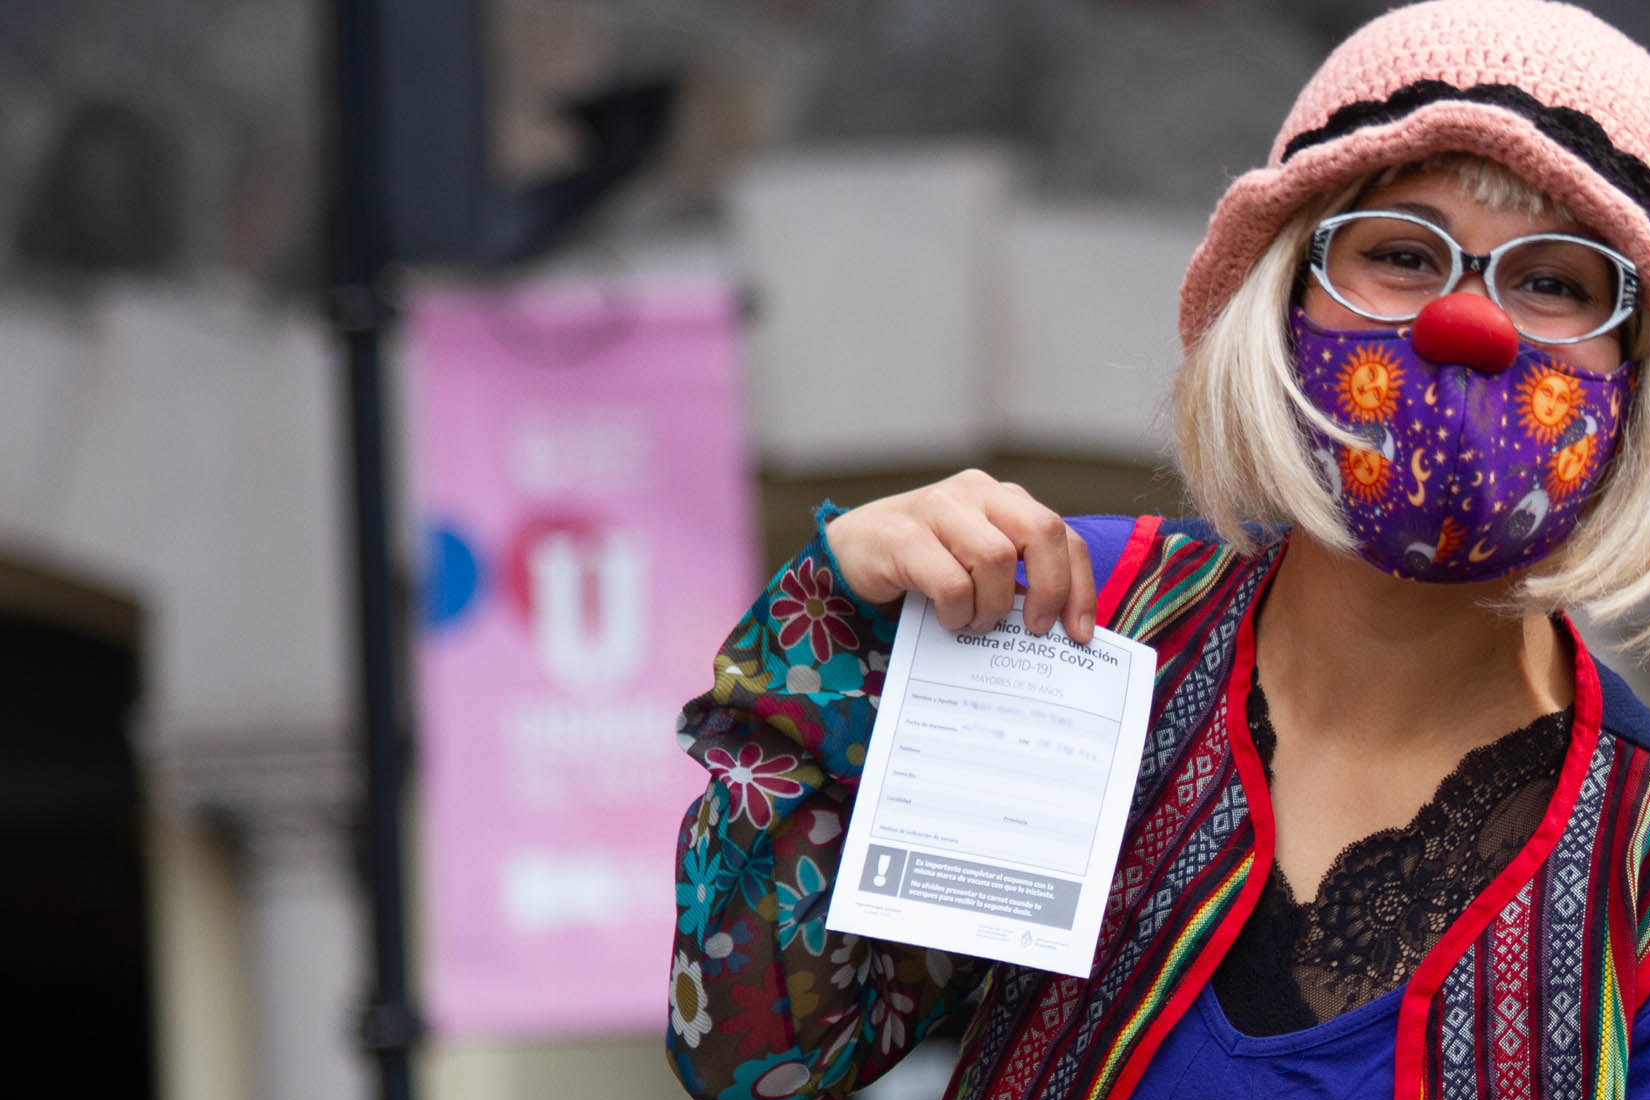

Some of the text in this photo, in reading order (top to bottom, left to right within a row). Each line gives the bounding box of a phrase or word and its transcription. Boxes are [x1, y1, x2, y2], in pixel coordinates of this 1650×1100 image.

[989, 618, 1021, 635] nico
[956, 633, 1095, 672] contra el SARS CoV2
[990, 655, 1053, 679] (COVID-19)
